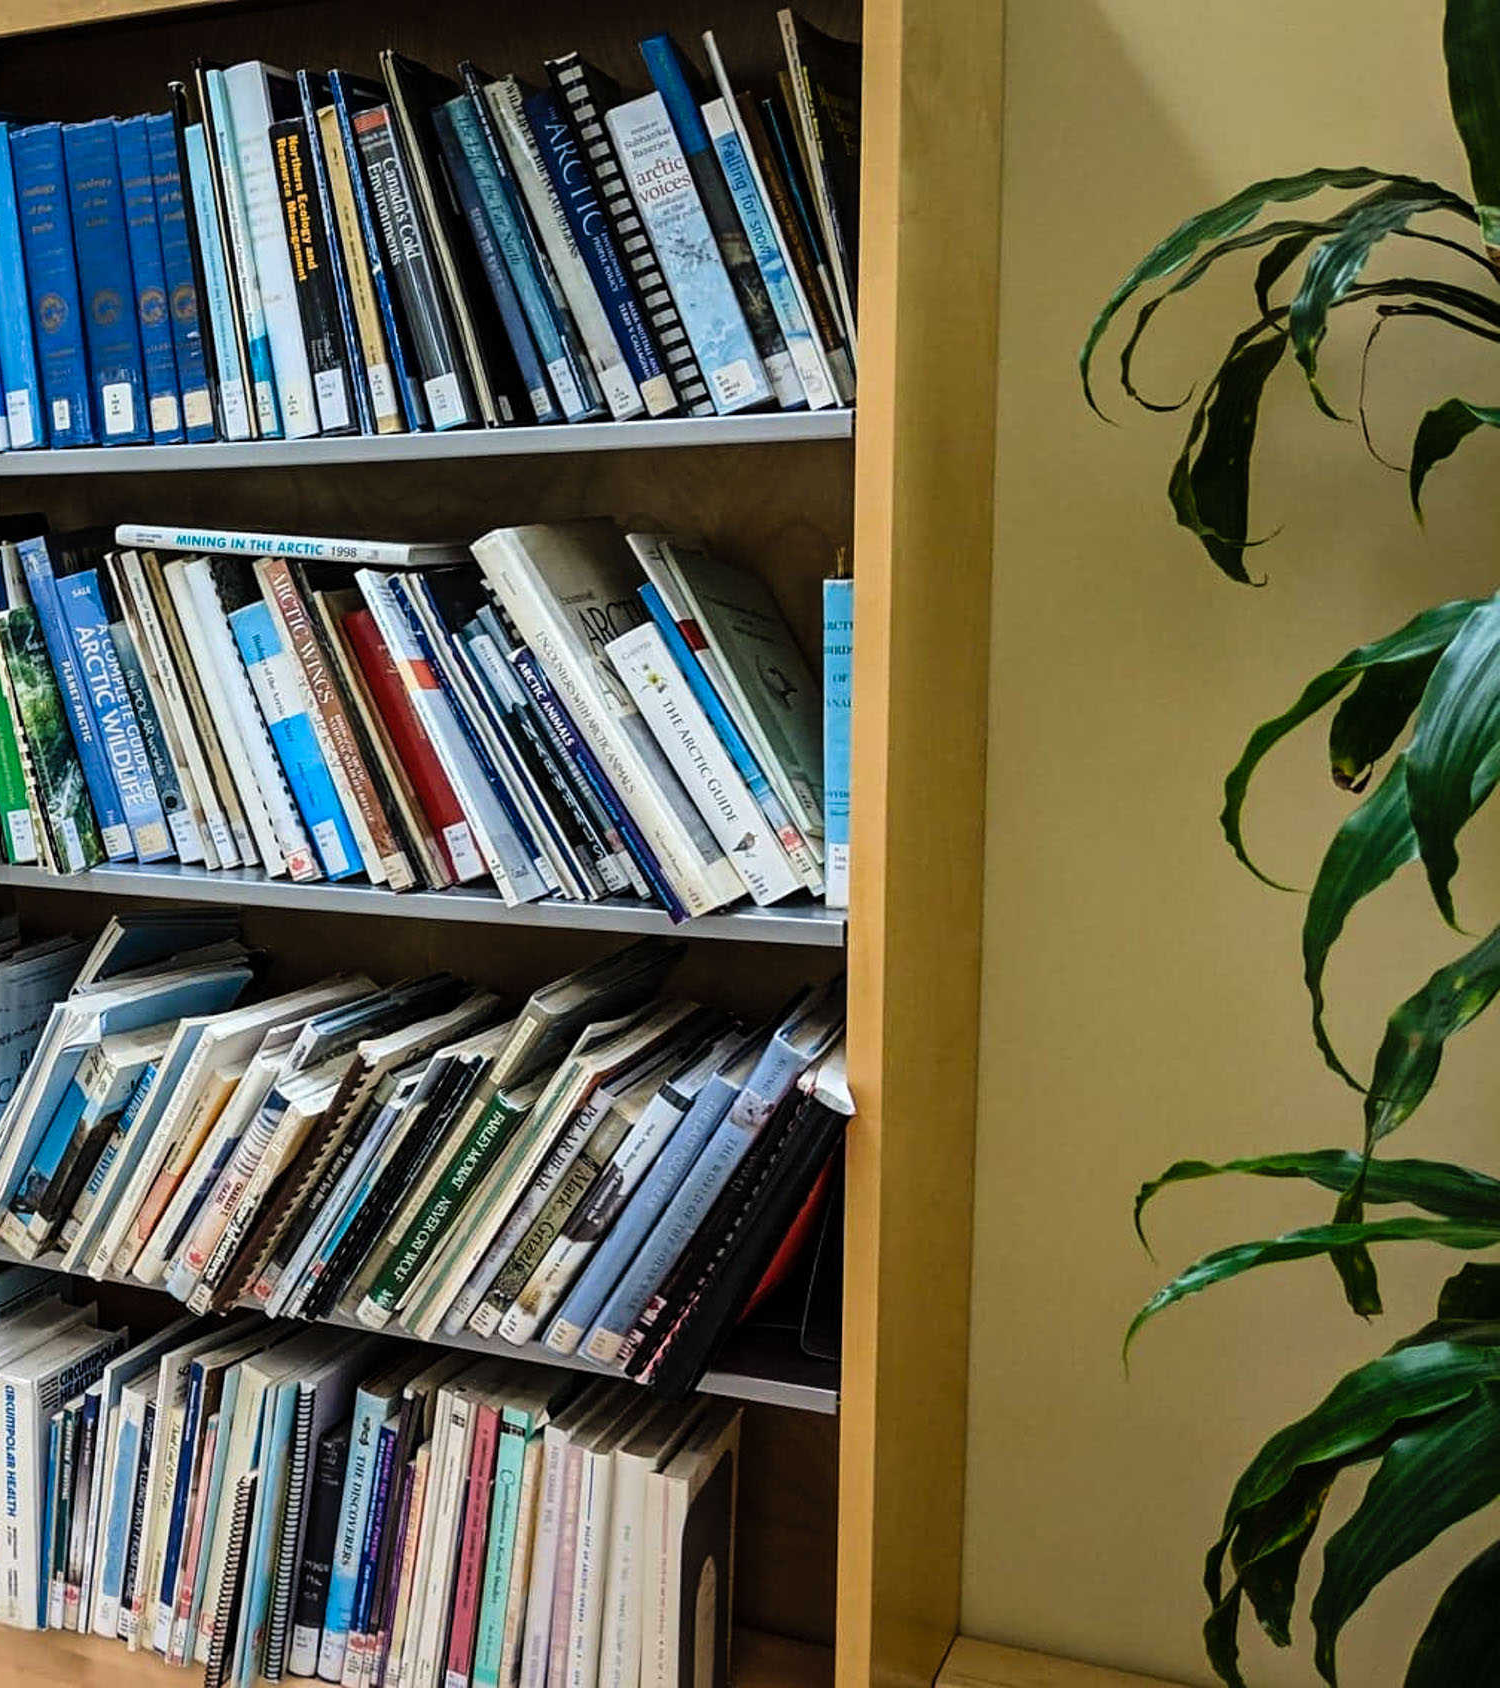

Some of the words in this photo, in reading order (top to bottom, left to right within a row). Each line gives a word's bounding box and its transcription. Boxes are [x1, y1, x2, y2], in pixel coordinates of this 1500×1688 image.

[275, 138, 295, 198] Resource
[287, 134, 307, 192] Northern
[539, 117, 611, 237] ARCTIC
[636, 157, 685, 186] arctic
[639, 173, 692, 203] voices
[718, 139, 751, 191] Falling
[294, 193, 314, 244] Ecology
[360, 162, 412, 267] Environments
[375, 155, 414, 225] Canada's
[395, 223, 422, 261] Cold
[740, 193, 759, 216] for
[284, 200, 308, 283] Management
[304, 245, 319, 270] and
[749, 219, 772, 257] snow
[176, 534, 227, 549] MINING
[230, 537, 245, 549] IN
[249, 538, 273, 552] THE
[277, 540, 324, 556] ARCTIC
[331, 545, 358, 559] 1998
[94, 621, 110, 636] A
[266, 569, 314, 641] ARCTIC
[294, 639, 339, 706] WINGS
[59, 659, 81, 702] PLANET
[72, 702, 93, 743] ARCTIC
[98, 637, 136, 722] COMPLETE
[515, 659, 548, 701] ARCTIC
[538, 697, 577, 748] ANIMALS
[72, 622, 118, 709] ARCTIC
[98, 707, 147, 808] WILDLIFE
[124, 722, 152, 774] GUIDE
[660, 698, 686, 729] THE
[675, 725, 714, 780] ARCTIC
[704, 775, 740, 826] GUIDE
[140, 777, 159, 802] TO
[472, 1109, 508, 1152] FARLEY
[558, 1102, 598, 1155] POLAR
[447, 1146, 484, 1191] MOWAT
[532, 1150, 567, 1194] BEAR
[553, 1166, 589, 1210] Mark
[420, 1194, 454, 1234] NEVER
[390, 1248, 419, 1283] WOLF
[408, 1228, 432, 1254] CRY
[1, 1385, 19, 1468] CIRCUMPOLAR
[352, 1454, 367, 1478] THE
[4, 1470, 19, 1518] HEALTH
[337, 1480, 364, 1566] DISCOVERERS
